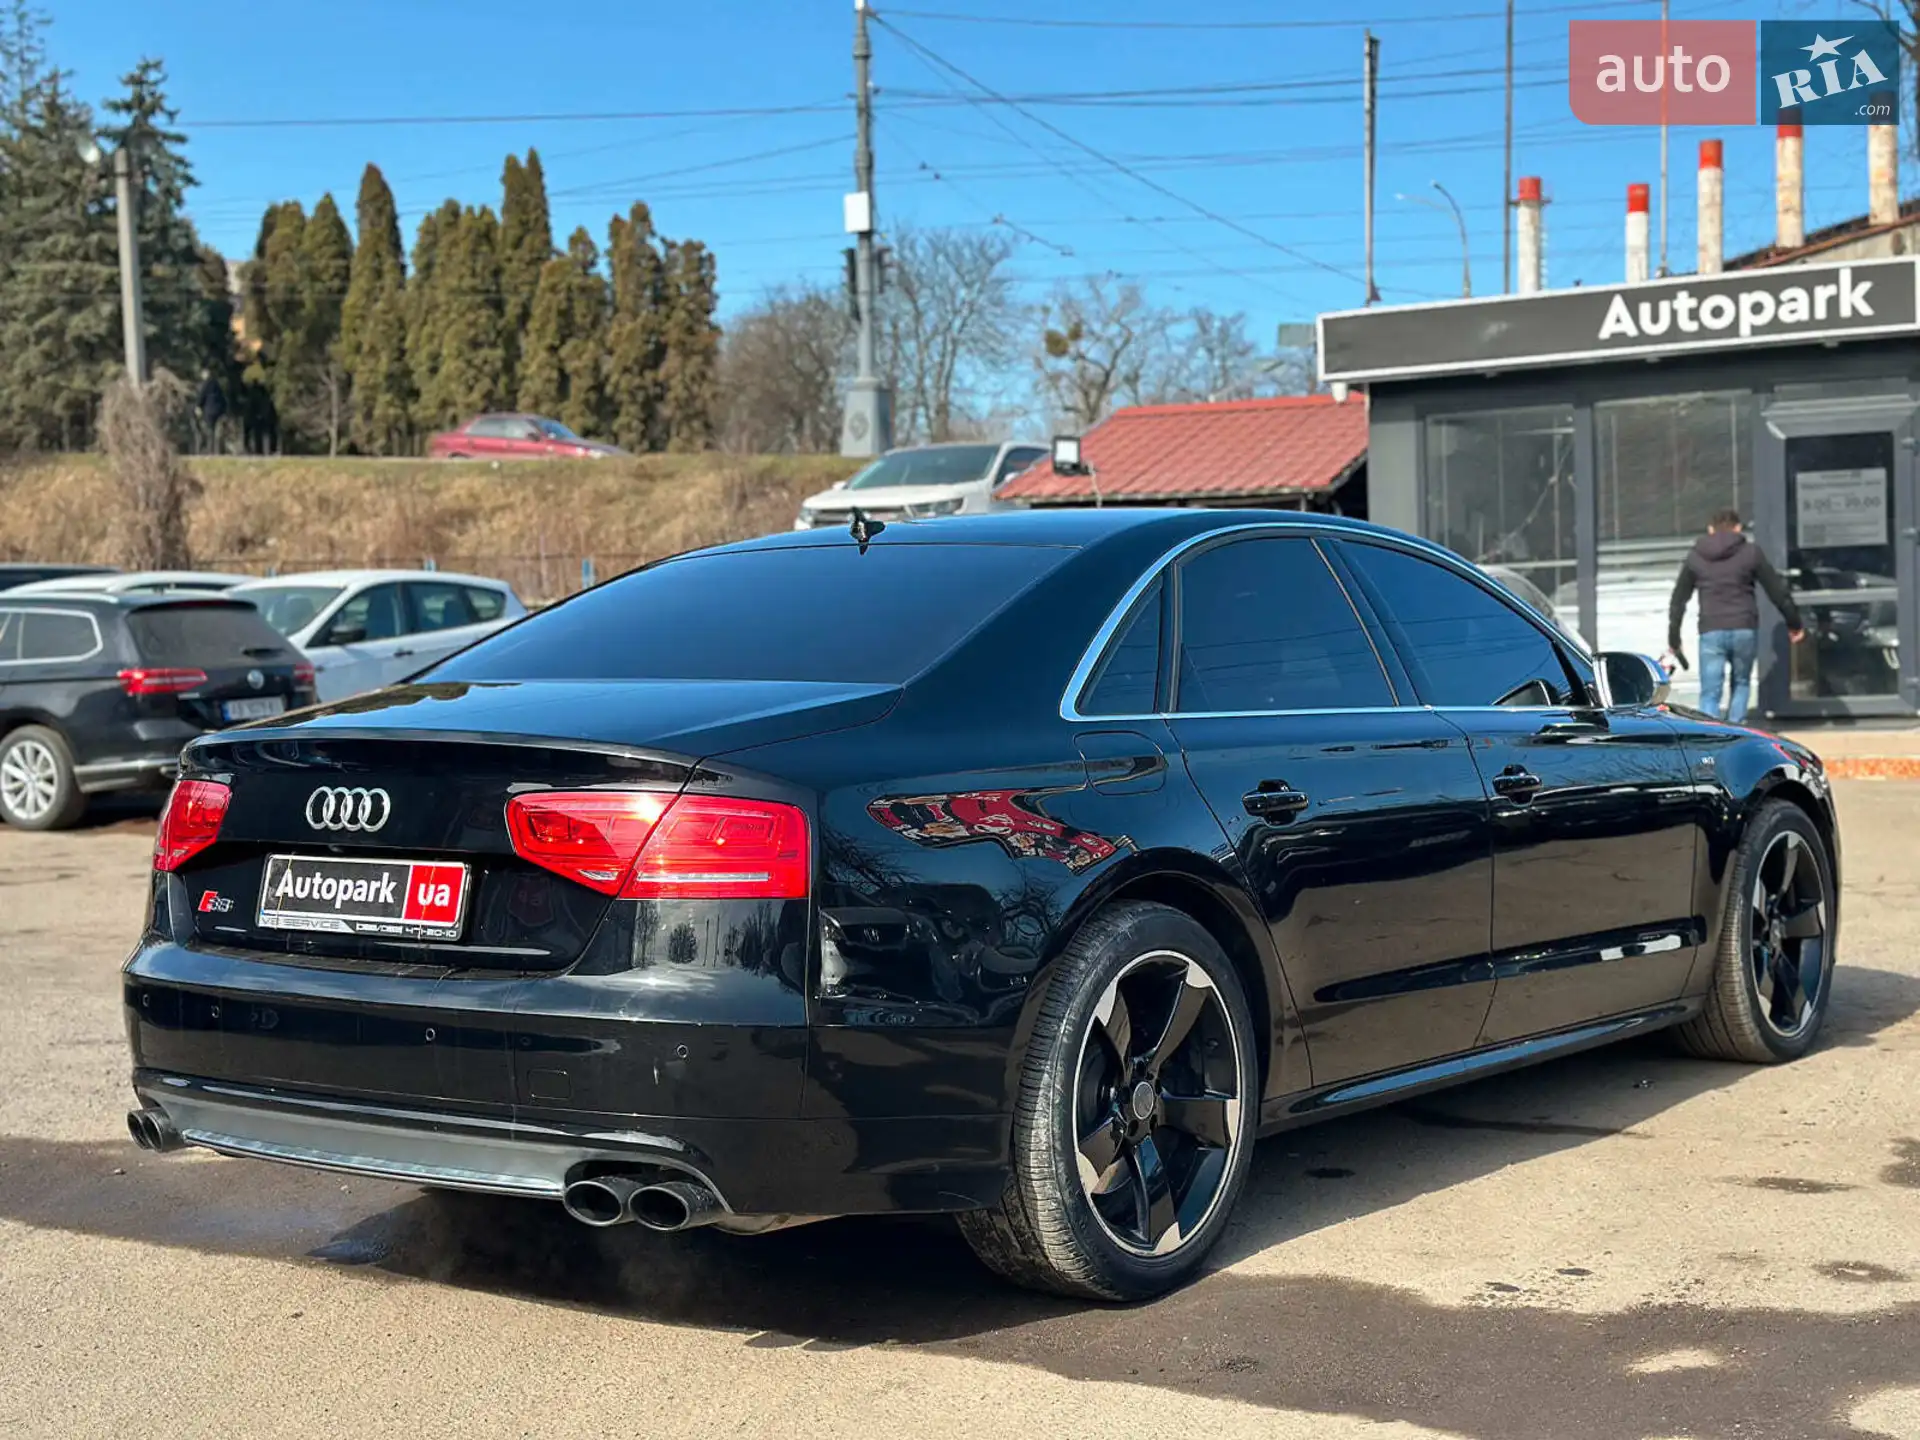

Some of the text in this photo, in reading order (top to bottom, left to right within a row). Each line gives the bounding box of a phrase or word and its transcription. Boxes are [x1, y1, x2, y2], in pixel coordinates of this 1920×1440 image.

[1599, 267, 1875, 340] Autopark
[275, 869, 451, 909] Autopark ua
